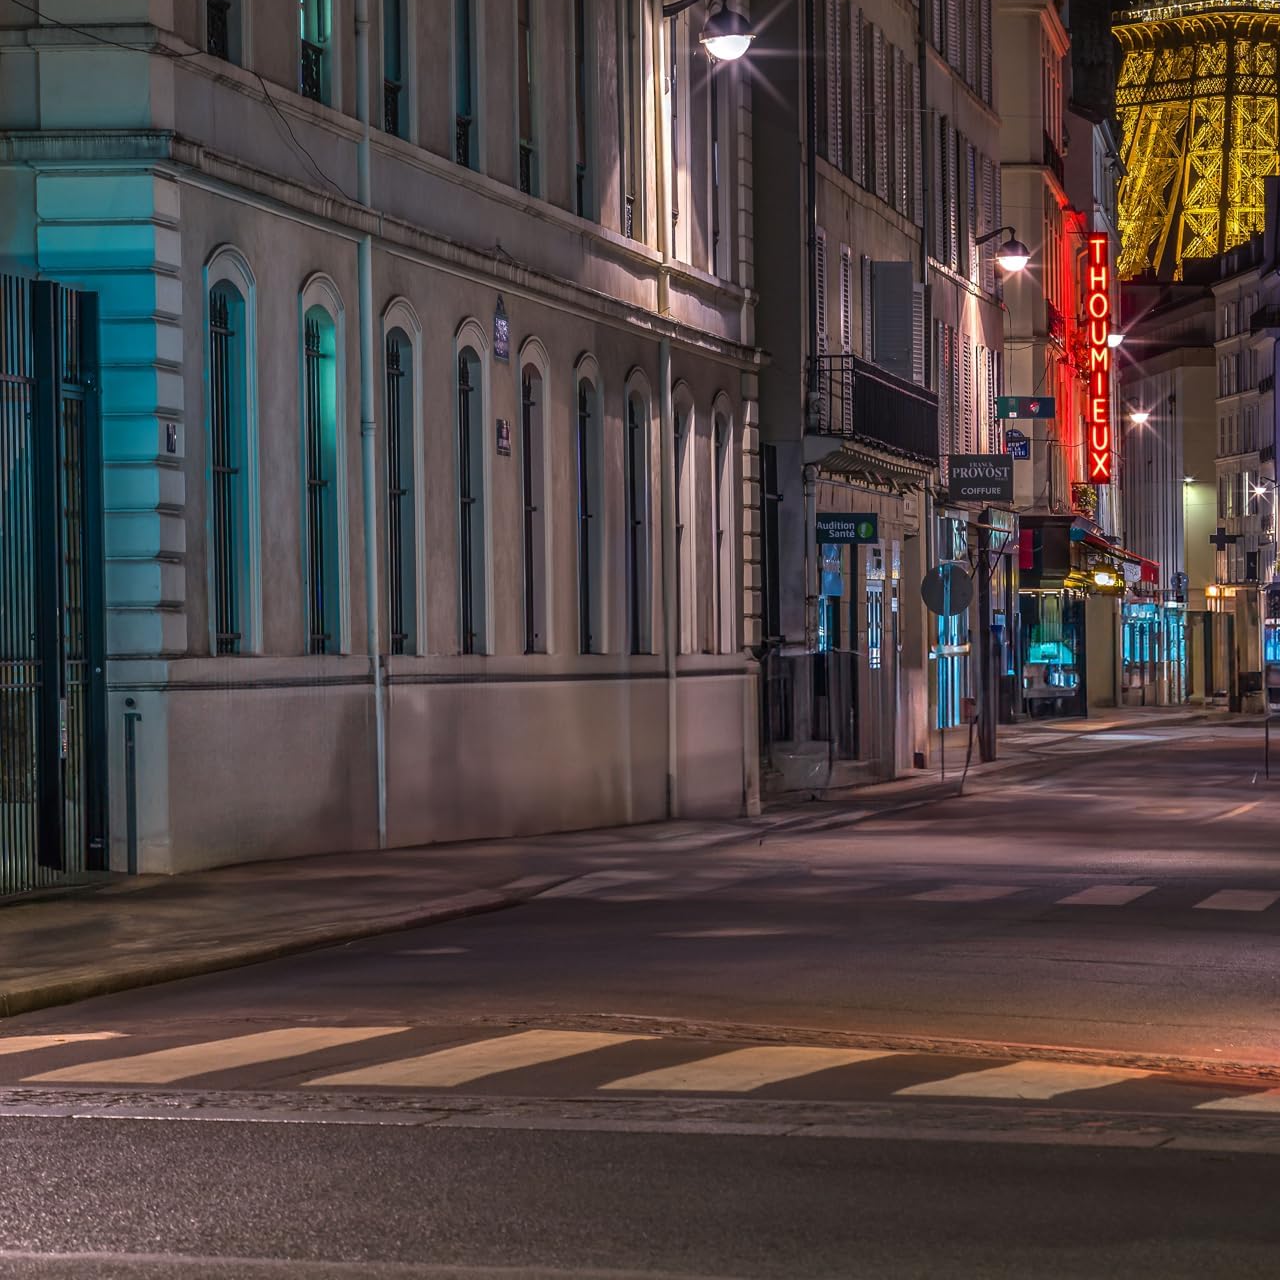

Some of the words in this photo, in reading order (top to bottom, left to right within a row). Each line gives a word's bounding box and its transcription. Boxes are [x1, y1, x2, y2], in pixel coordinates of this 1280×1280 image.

[1089, 239, 1109, 477] THOUMIEUX
[952, 467, 1010, 478] PROVOST
[961, 487, 1001, 495] COIFFURE
[817, 521, 855, 530] Audition
[829, 529, 855, 538] Santé
